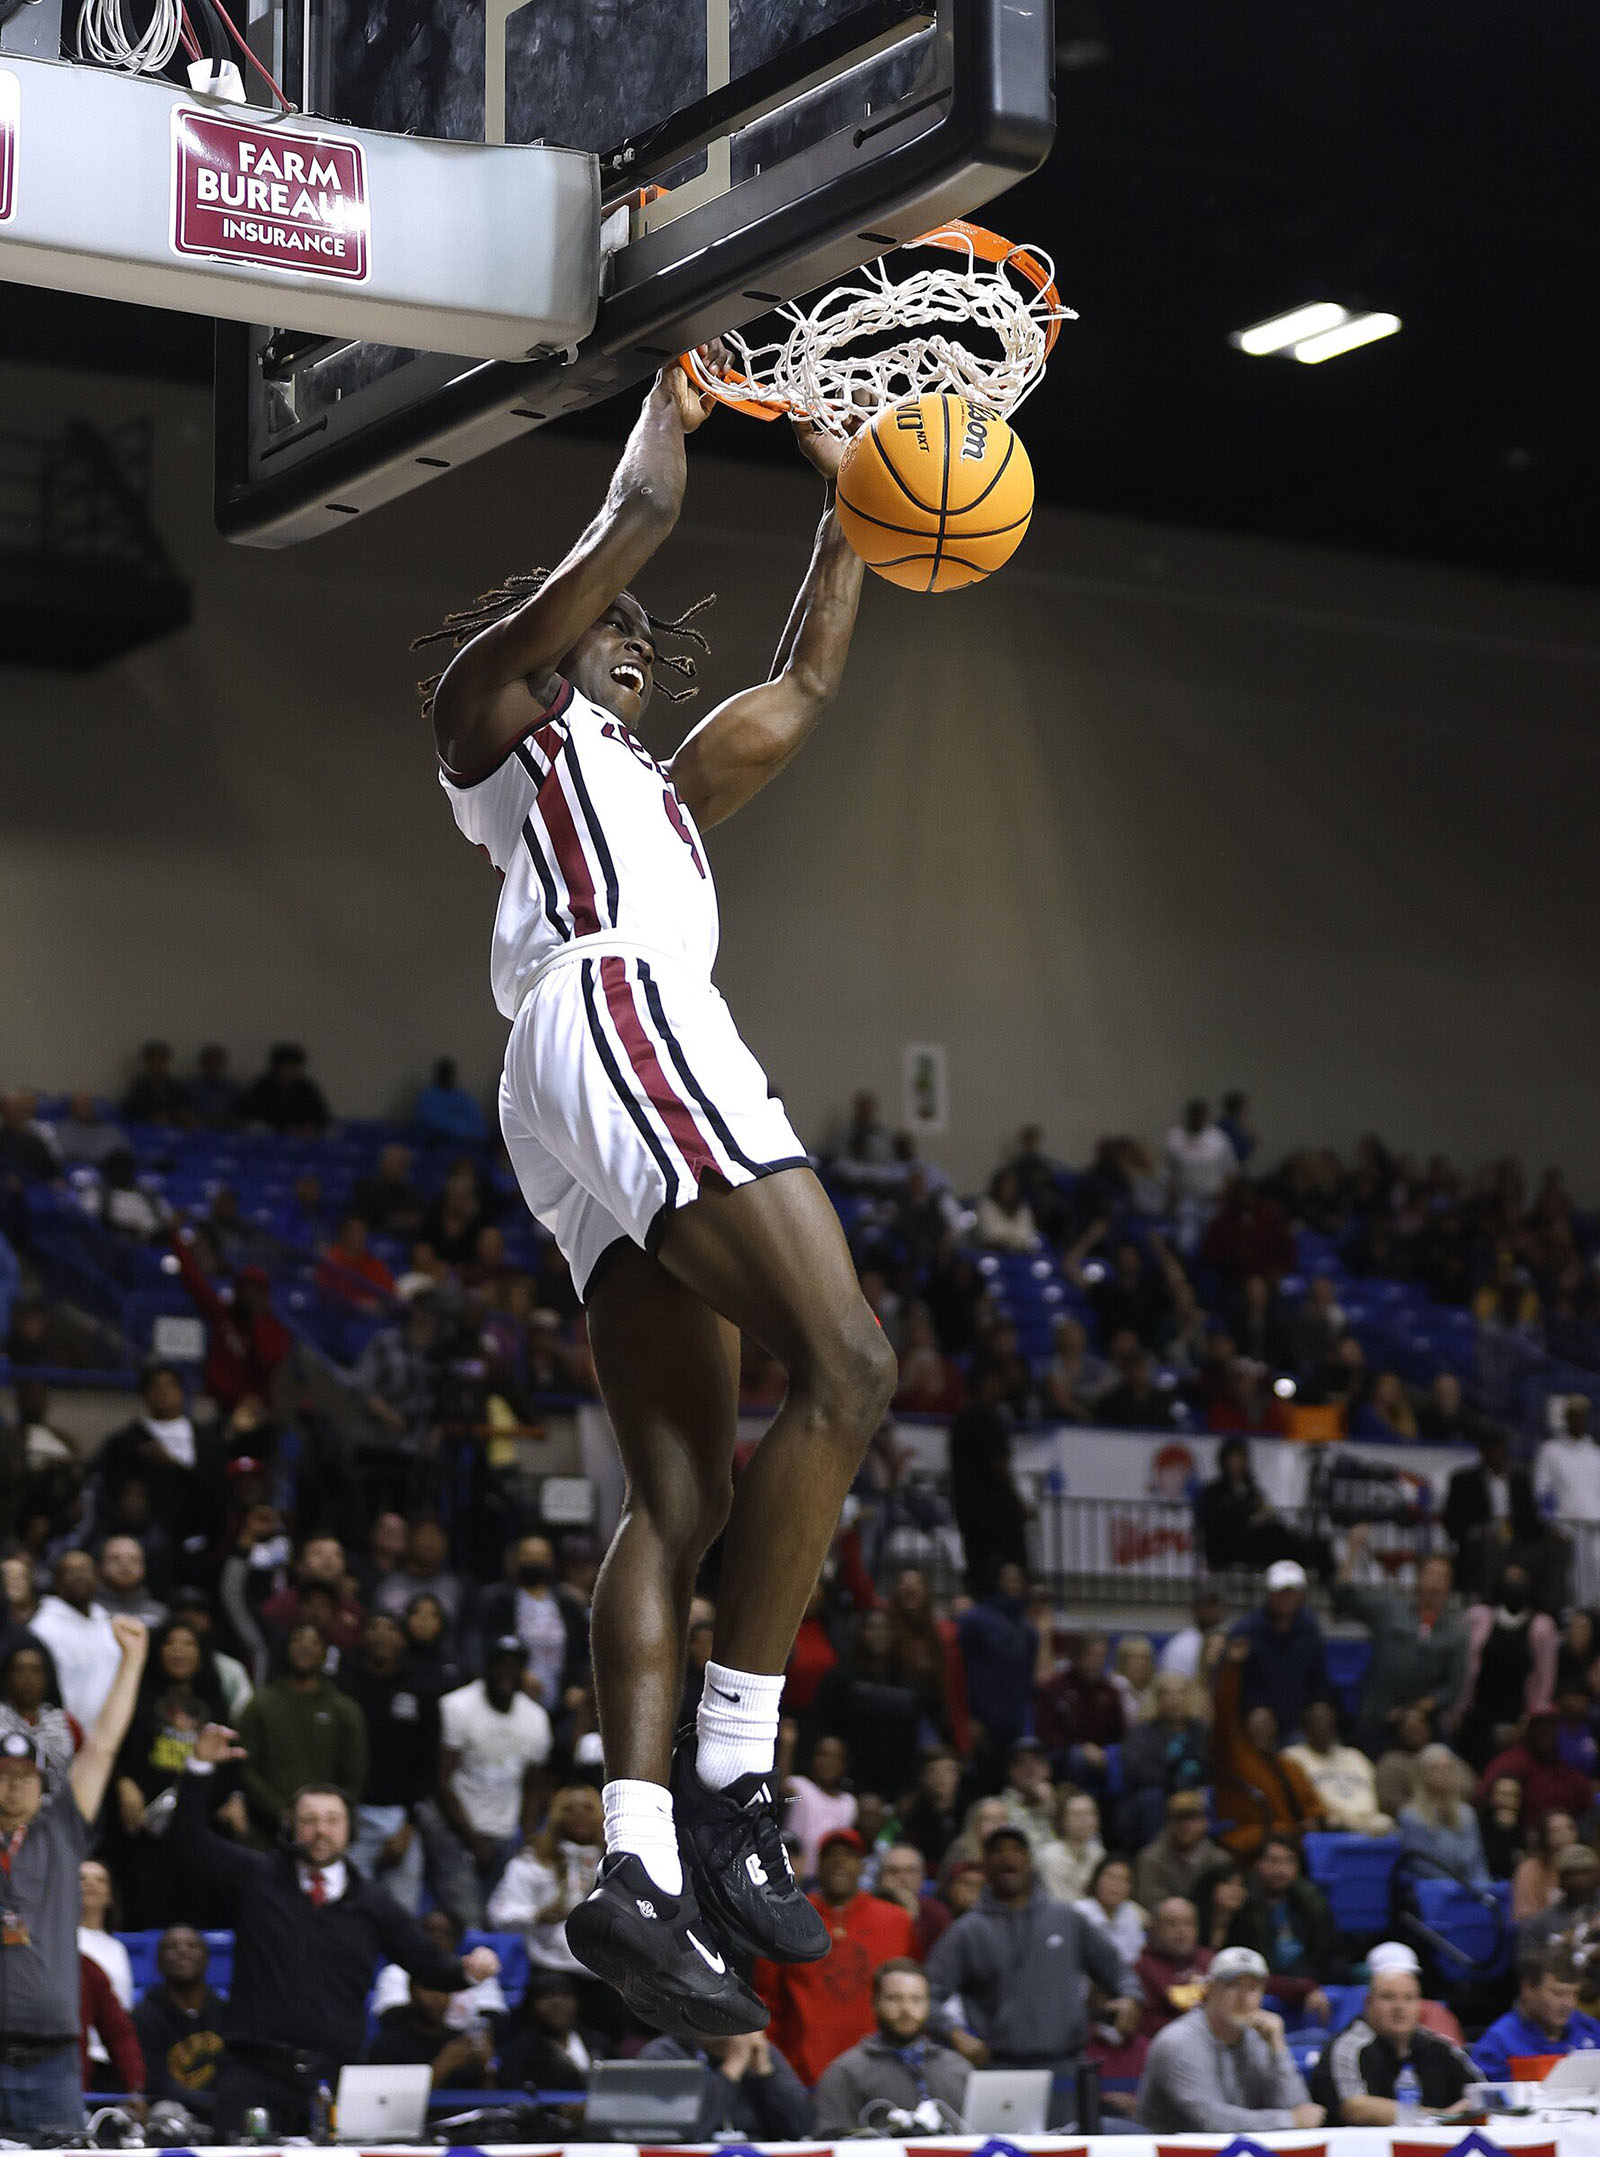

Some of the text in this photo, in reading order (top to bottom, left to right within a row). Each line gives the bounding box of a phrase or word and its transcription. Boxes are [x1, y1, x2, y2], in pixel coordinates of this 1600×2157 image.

[239, 141, 342, 191] FARM
[197, 167, 346, 224] BUREAU
[222, 218, 346, 257] INSURANCE
[896, 395, 930, 453] VO NXT
[962, 399, 998, 459] lson
